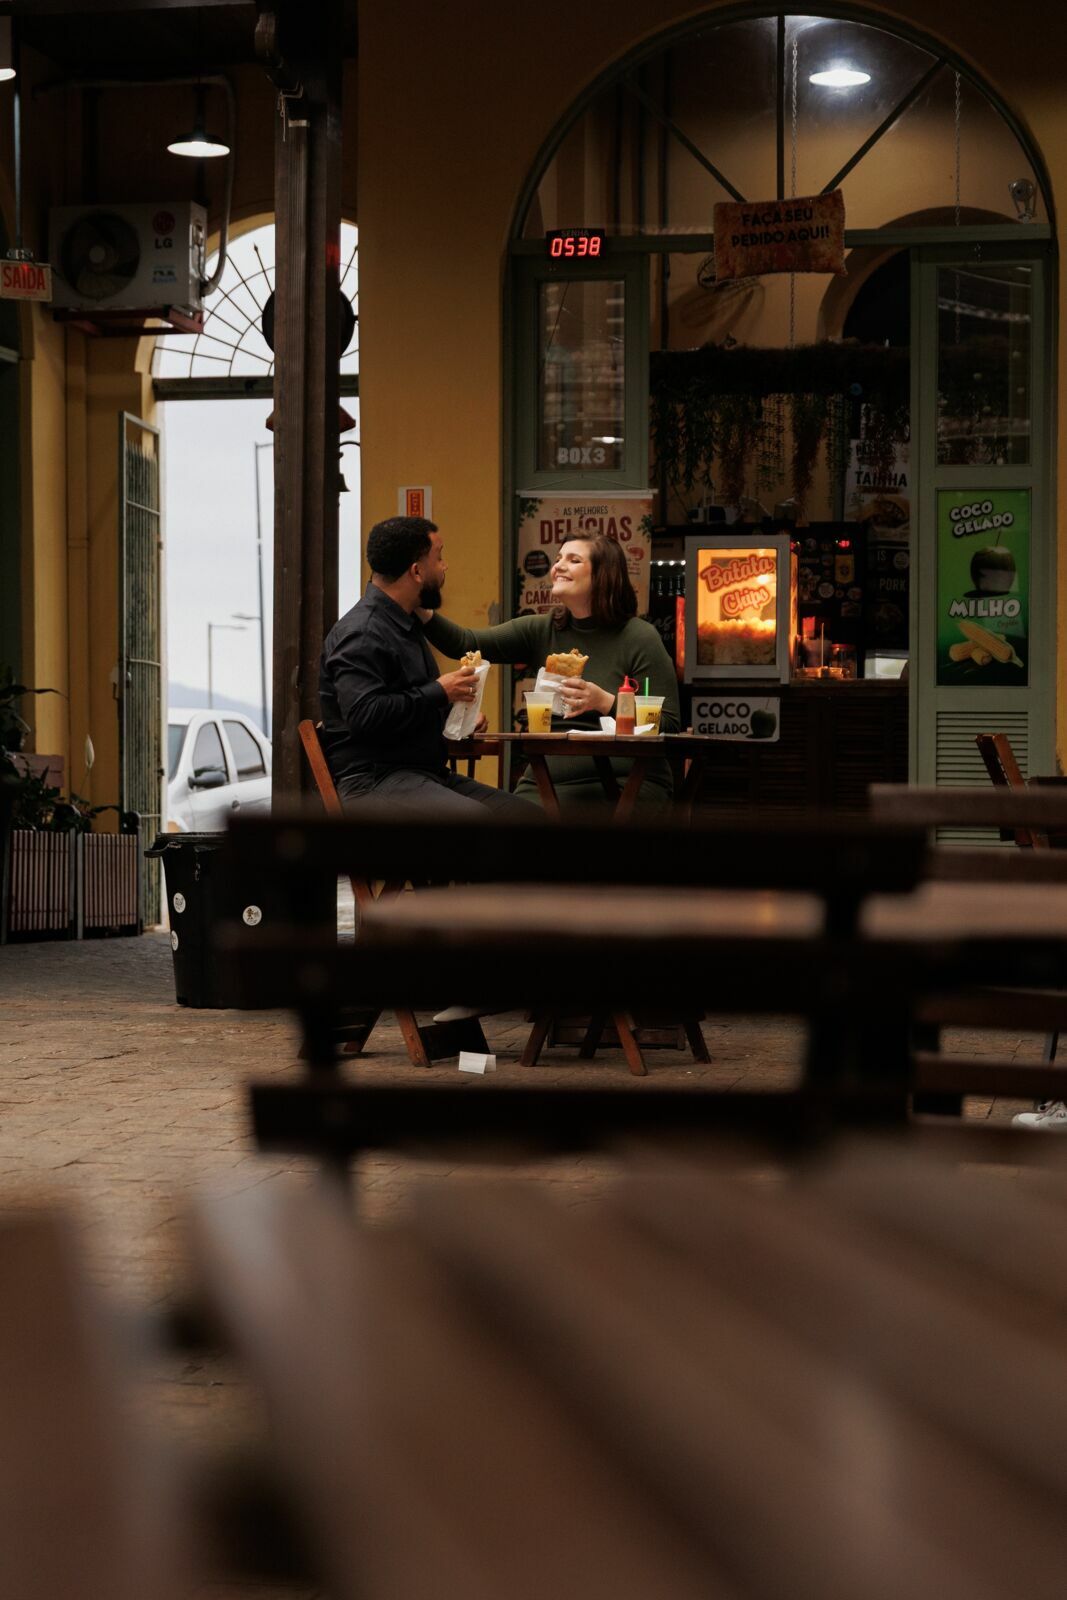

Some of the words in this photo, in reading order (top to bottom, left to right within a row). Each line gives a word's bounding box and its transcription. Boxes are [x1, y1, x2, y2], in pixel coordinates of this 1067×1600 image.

[742, 208, 784, 227] FAÇA
[786, 208, 813, 223] SEU
[155, 238, 173, 249] LG
[732, 231, 784, 247] PEDIDO
[788, 225, 829, 243] AQUI!
[551, 236, 601, 257] 0538
[563, 507, 572, 516] AS
[574, 506, 609, 515] MELHORES
[950, 500, 993, 521] COCO
[953, 512, 1014, 538] GELADO
[701, 554, 774, 592] Batata
[721, 586, 771, 616] Chips
[949, 599, 1021, 618] MILHO
[697, 702, 750, 718] COCO
[698, 723, 749, 735] GELADO
